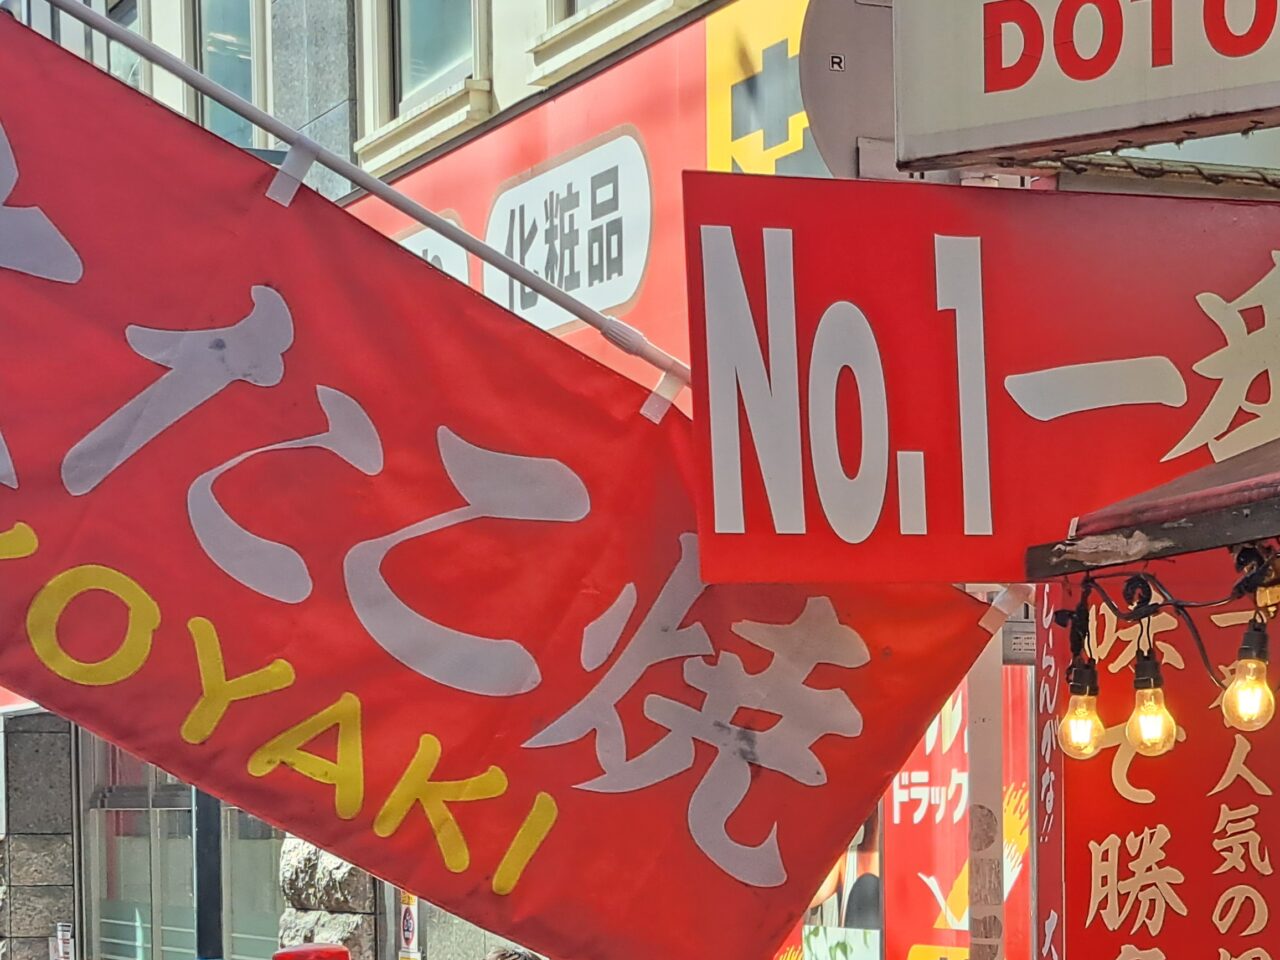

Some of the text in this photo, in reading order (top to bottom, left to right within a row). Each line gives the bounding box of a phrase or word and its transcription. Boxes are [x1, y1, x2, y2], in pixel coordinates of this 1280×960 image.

[831, 56, 843, 70] R
[505, 165, 623, 313] 化粧品
[701, 225, 993, 544] No.1
[0, 120, 872, 888] たこ焼
[0, 522, 558, 896] OYAKI
